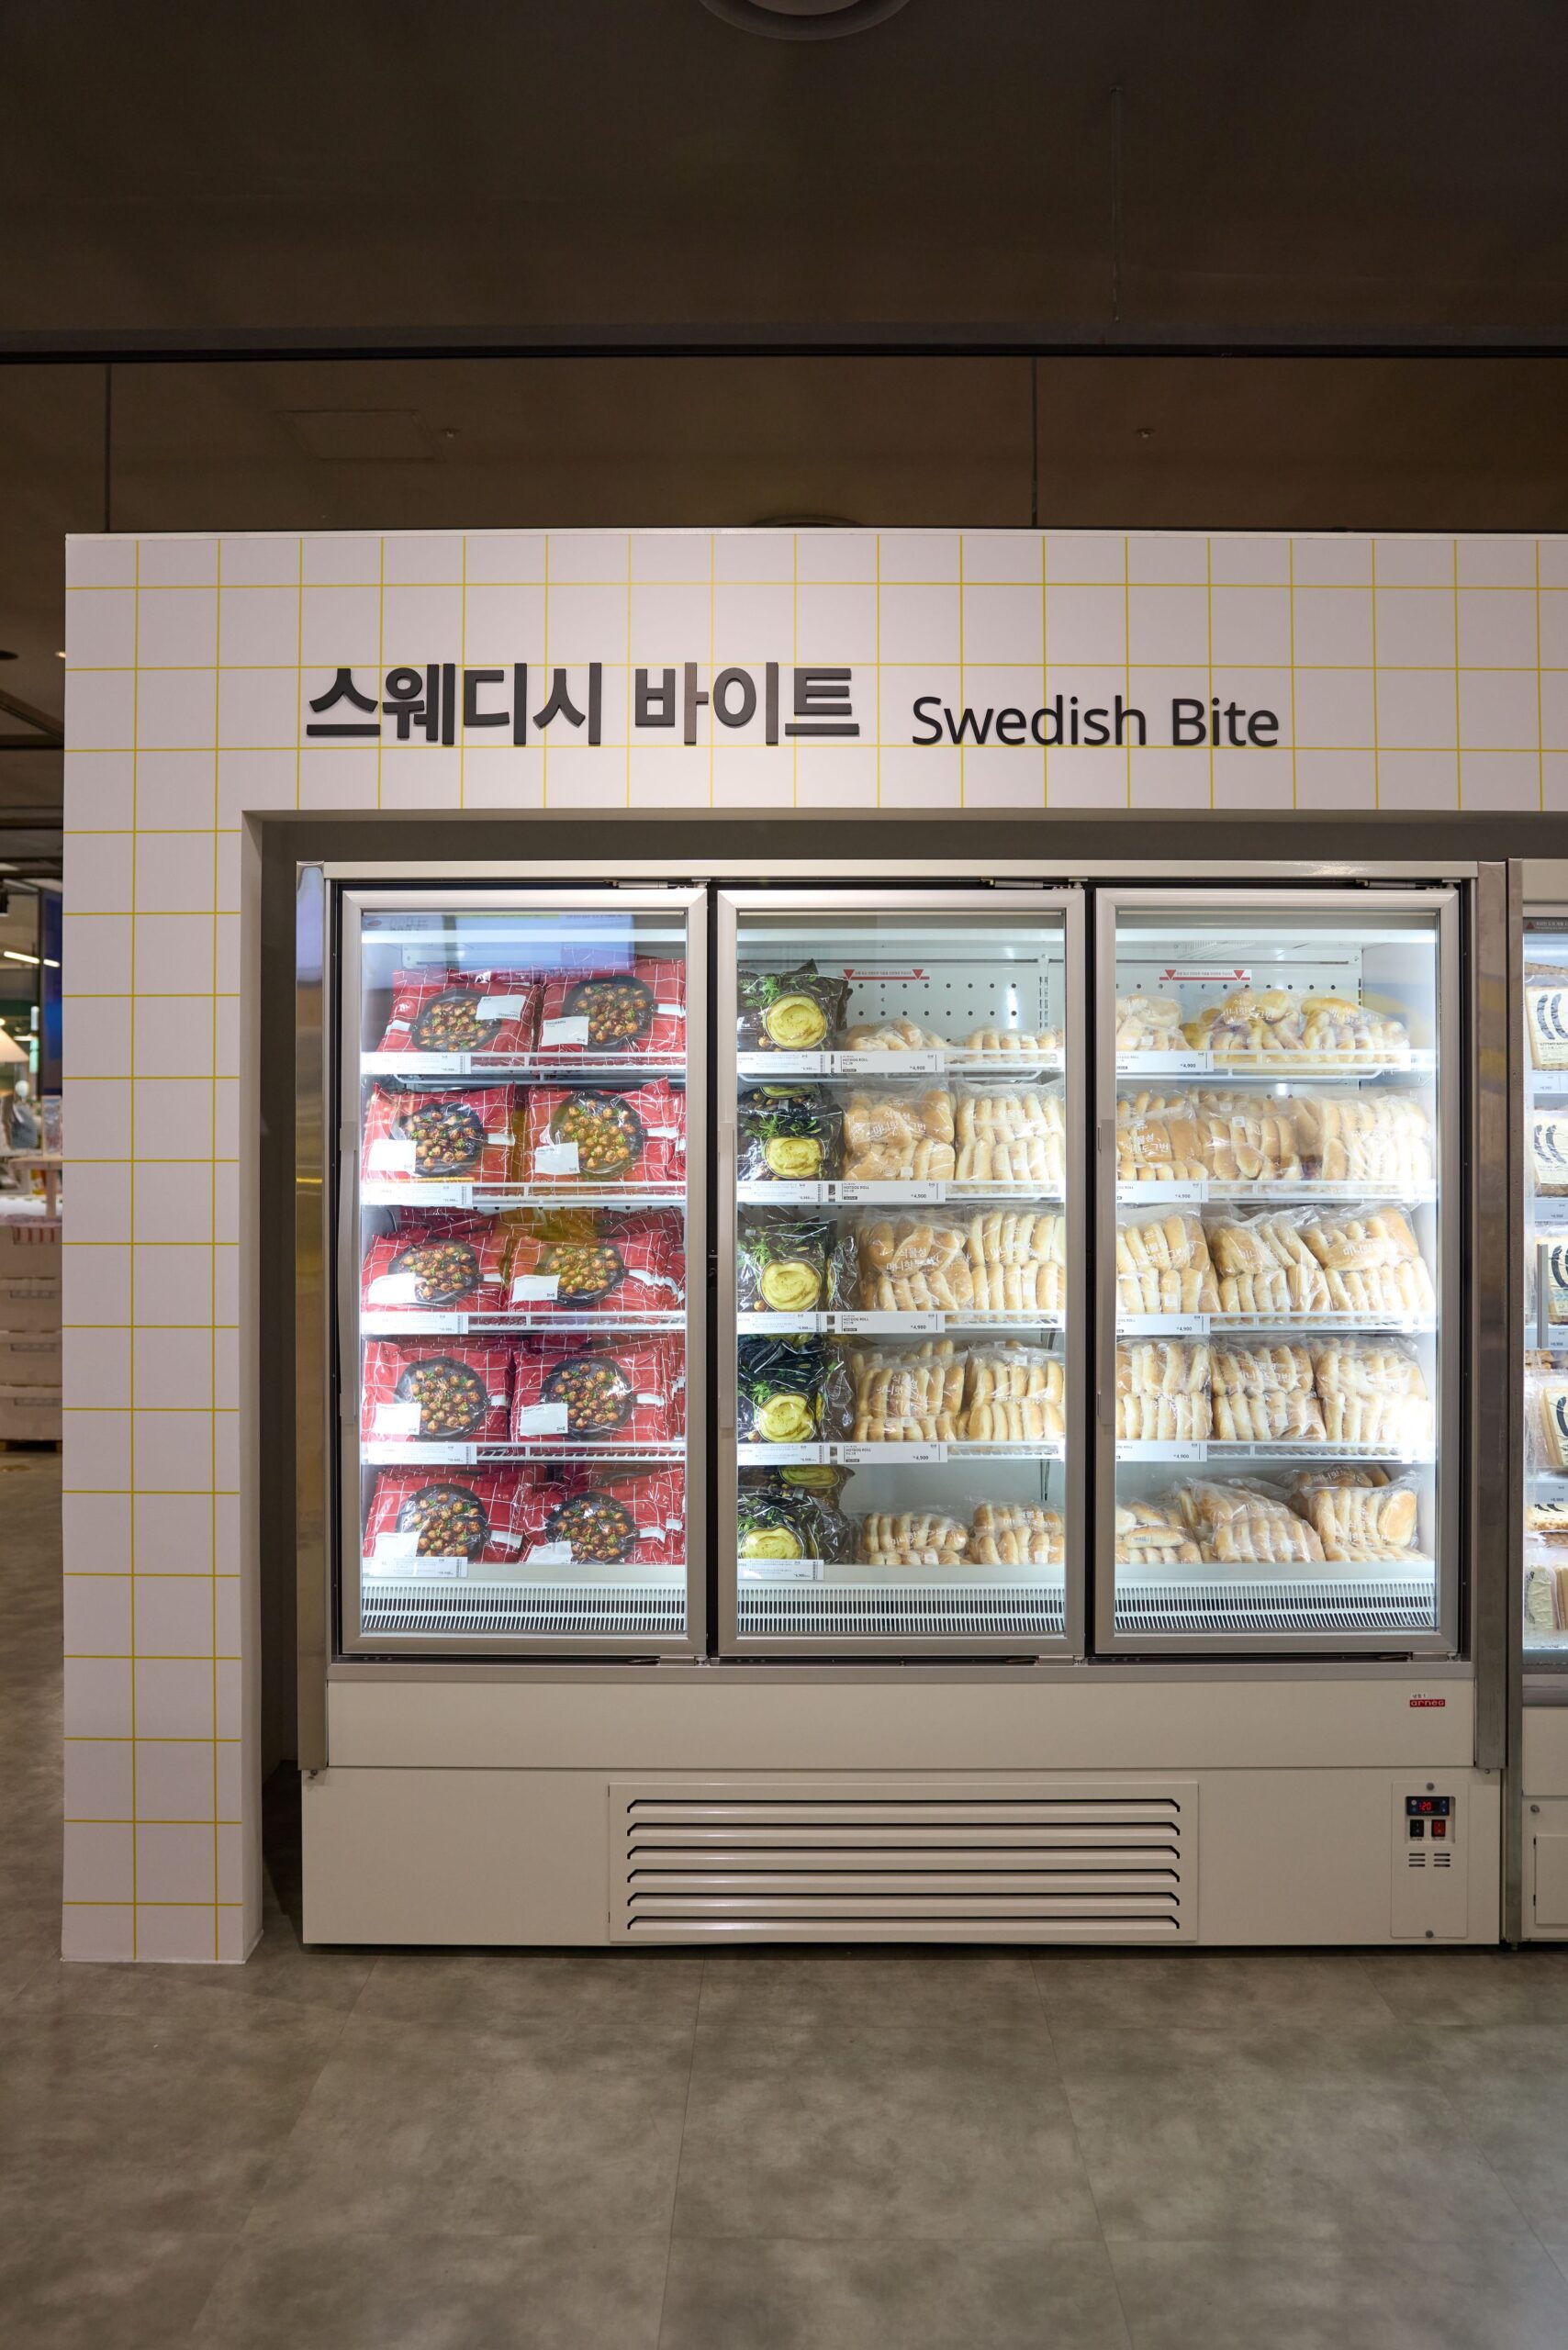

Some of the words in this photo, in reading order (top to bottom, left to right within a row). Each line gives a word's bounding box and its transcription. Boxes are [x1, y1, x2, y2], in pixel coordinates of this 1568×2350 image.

[306, 662, 602, 746] 스웨디시
[634, 662, 860, 746] 바이트
[912, 694, 1147, 746] Swedish
[1171, 697, 1279, 747] Bite
